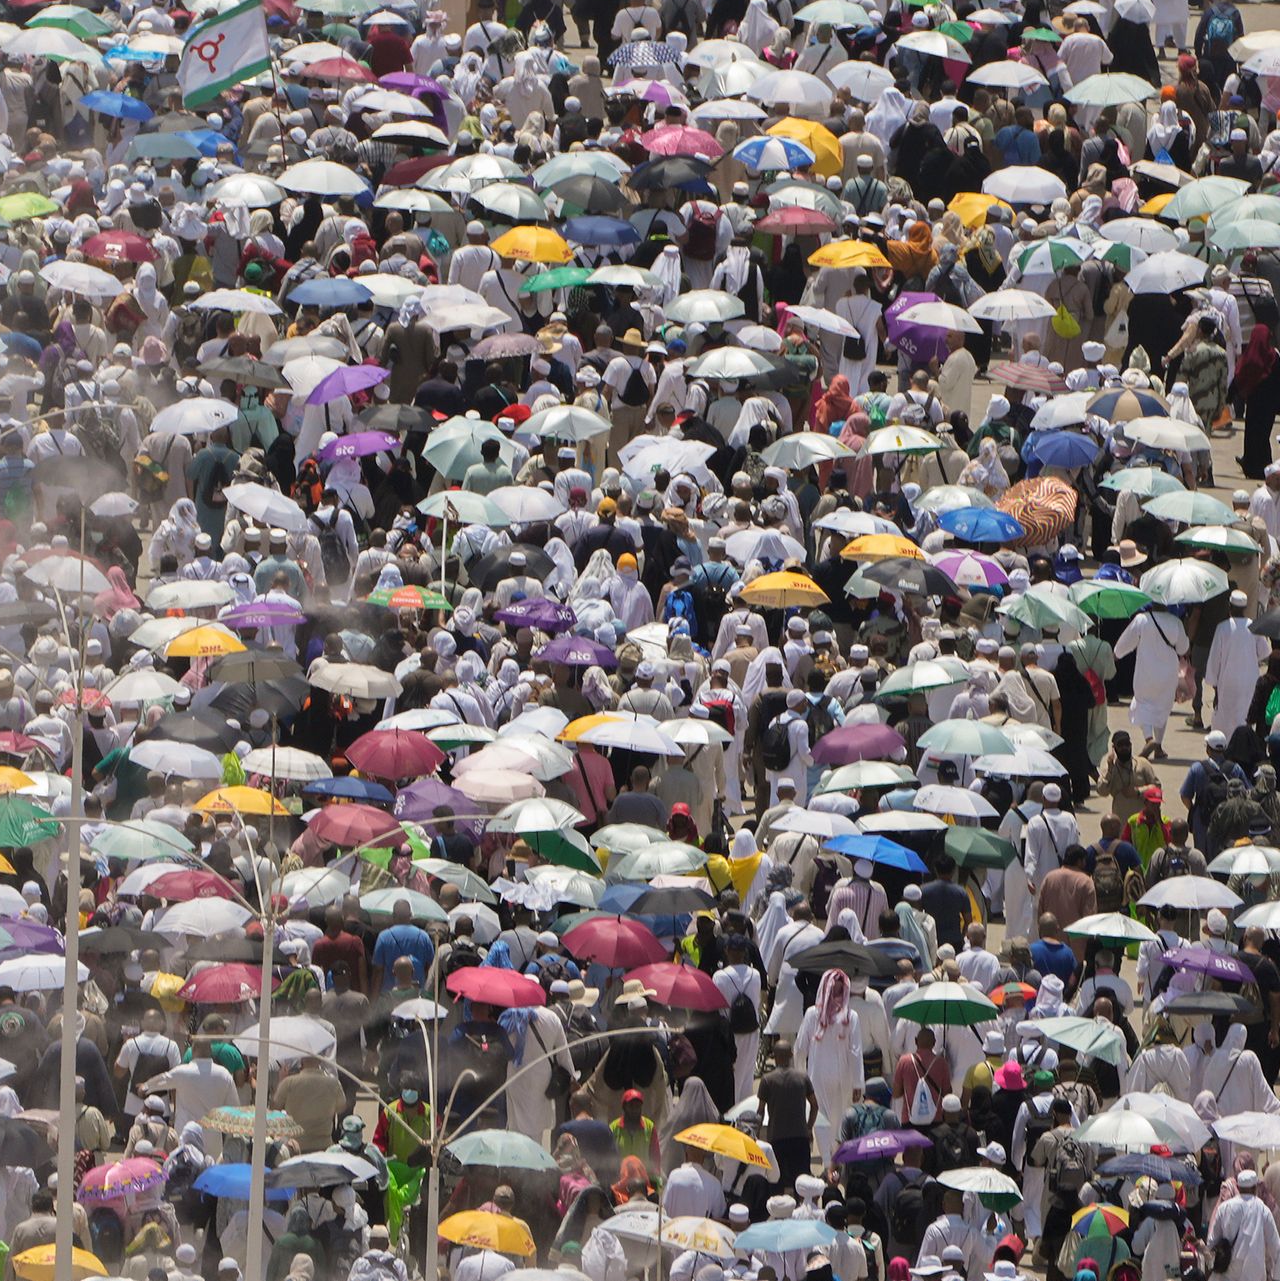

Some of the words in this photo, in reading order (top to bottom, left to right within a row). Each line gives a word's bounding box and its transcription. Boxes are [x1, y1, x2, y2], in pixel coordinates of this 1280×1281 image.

[898, 338, 918, 354] stc
[335, 445, 354, 456] stc
[245, 615, 266, 624] stc
[200, 645, 224, 654] DHL
[570, 651, 592, 661] stc
[1215, 959, 1236, 972] stc
[866, 1137, 889, 1148] stc
[748, 1152, 768, 1167] DHL
